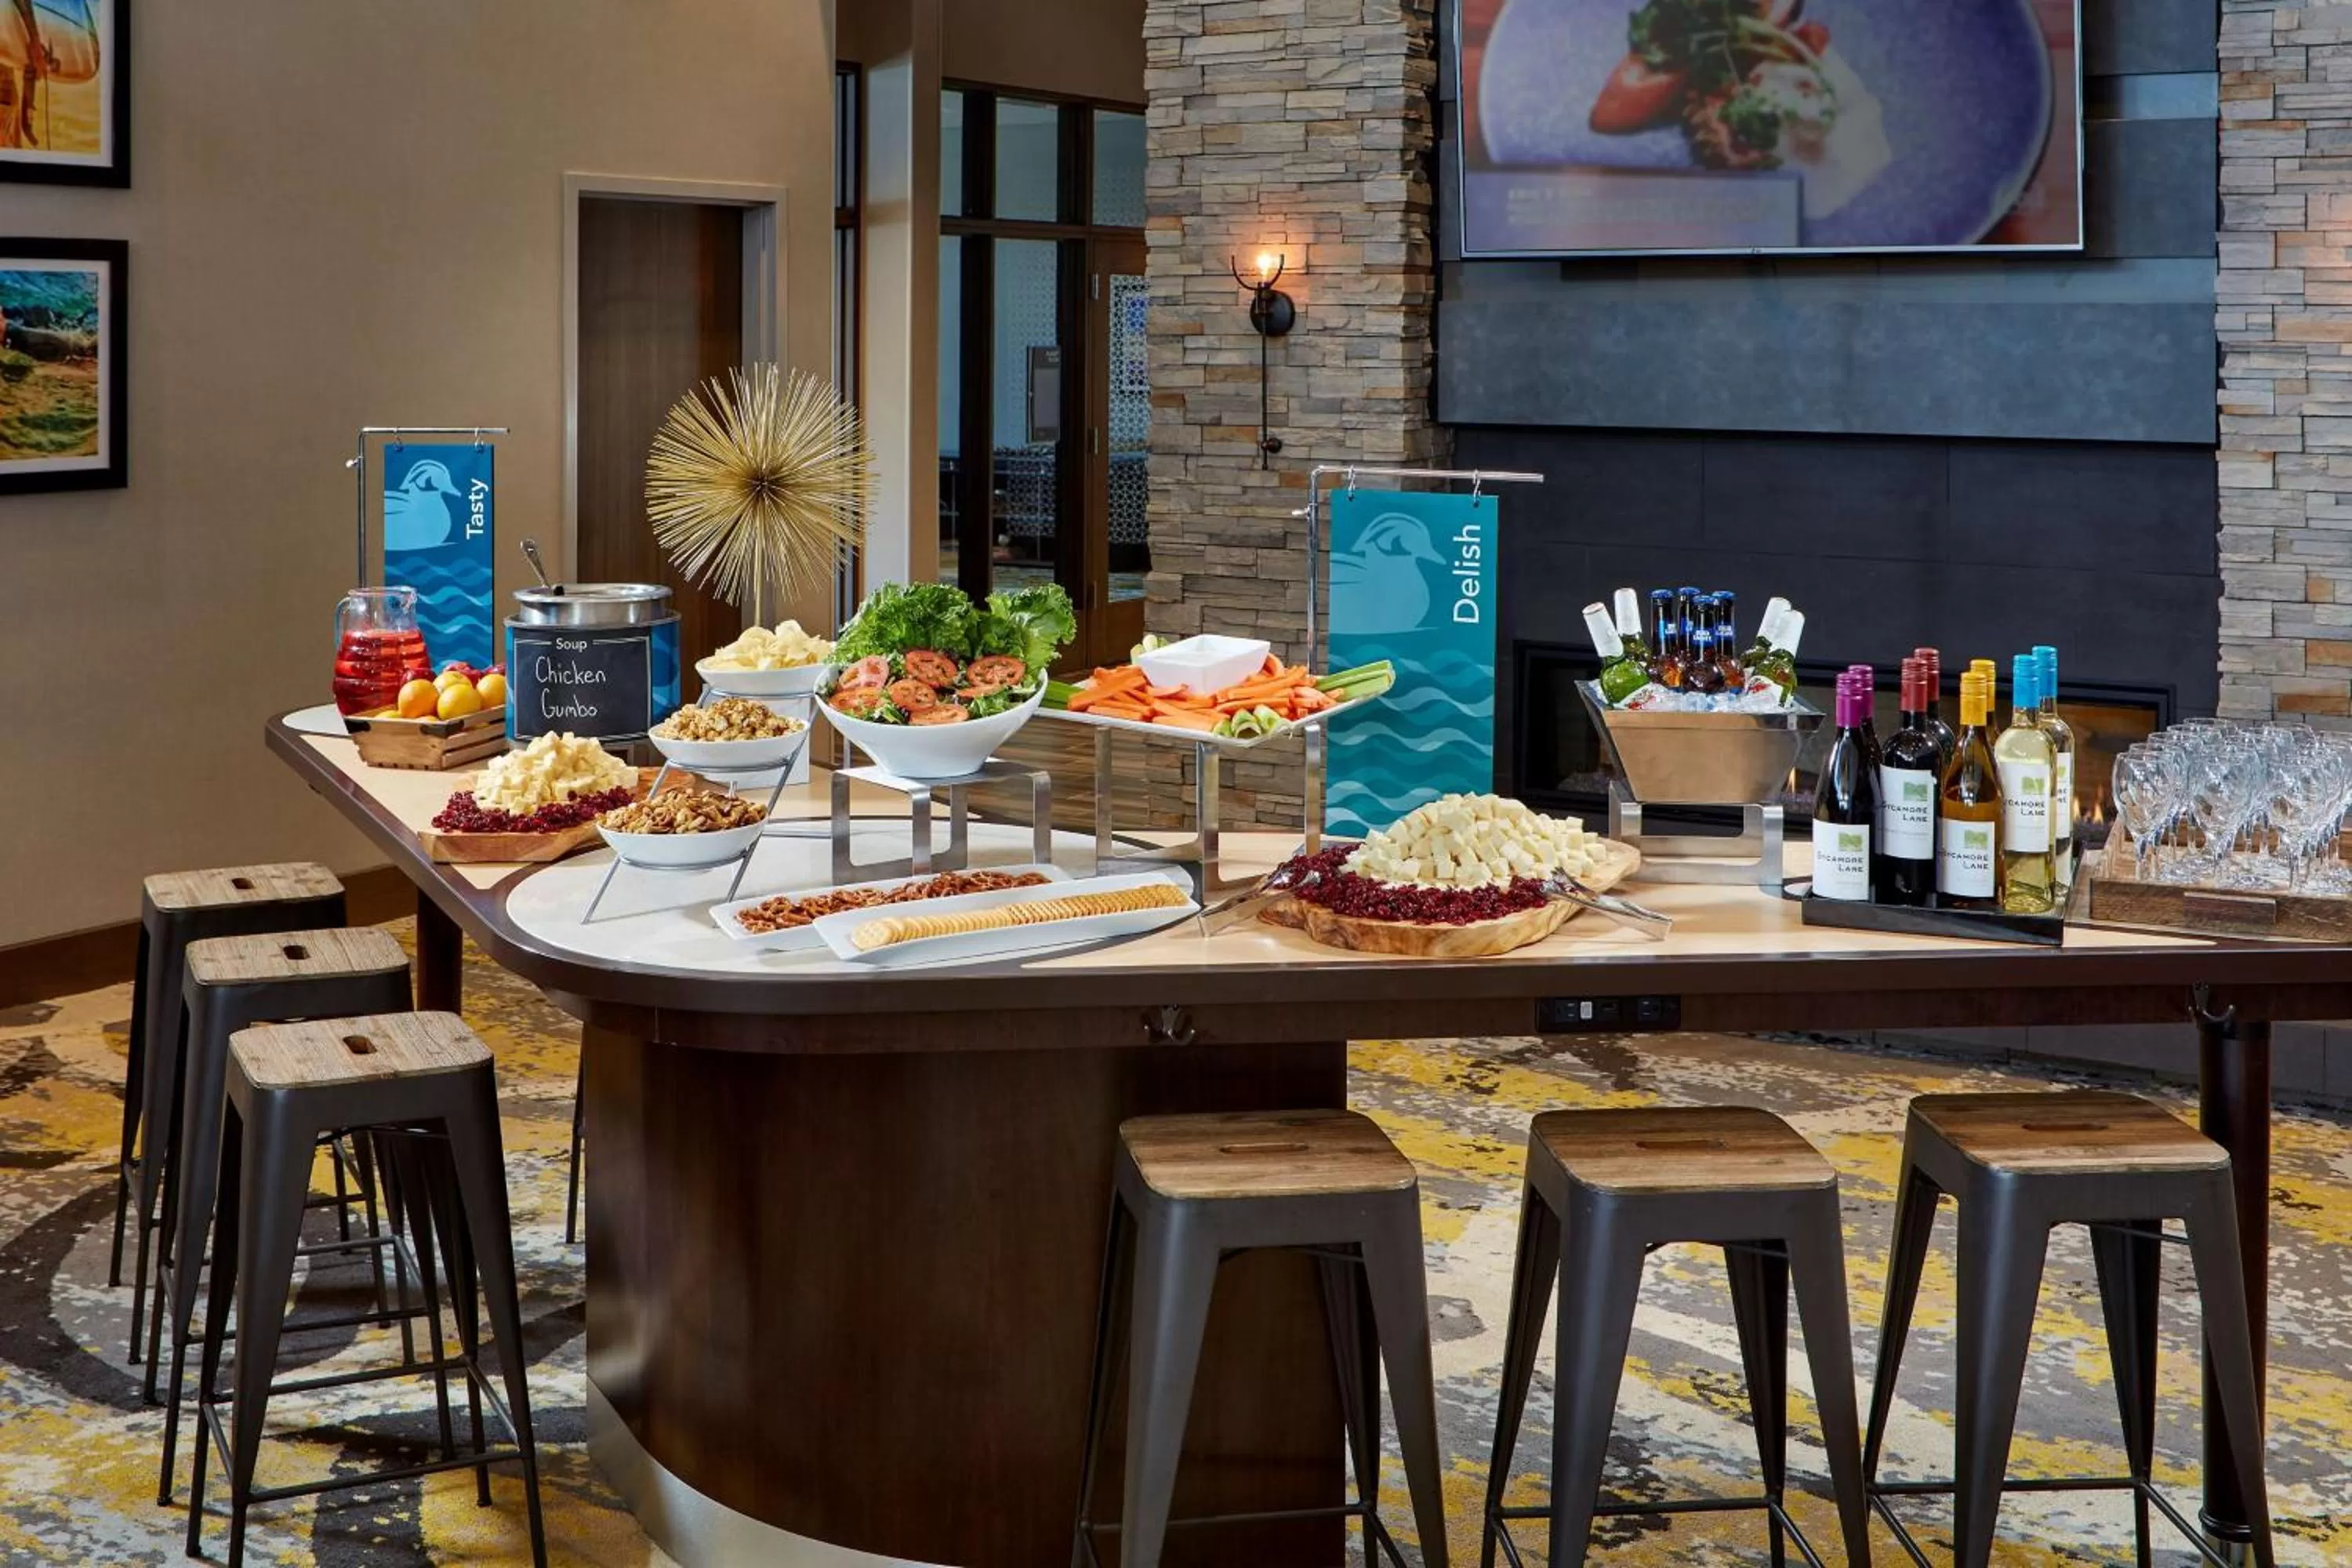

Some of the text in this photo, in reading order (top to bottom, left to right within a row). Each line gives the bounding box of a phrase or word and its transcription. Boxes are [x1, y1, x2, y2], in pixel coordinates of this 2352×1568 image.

[466, 478, 488, 539] Tasty
[1453, 524, 1480, 623] Delish
[556, 638, 587, 652] Soup
[535, 656, 606, 684] Chicken
[541, 688, 598, 718] Gumbo
[1903, 814, 1928, 822] LANE
[2020, 806, 2045, 816] LANE
[1838, 864, 1864, 873] LANE
[1962, 860, 1988, 869] LANE
